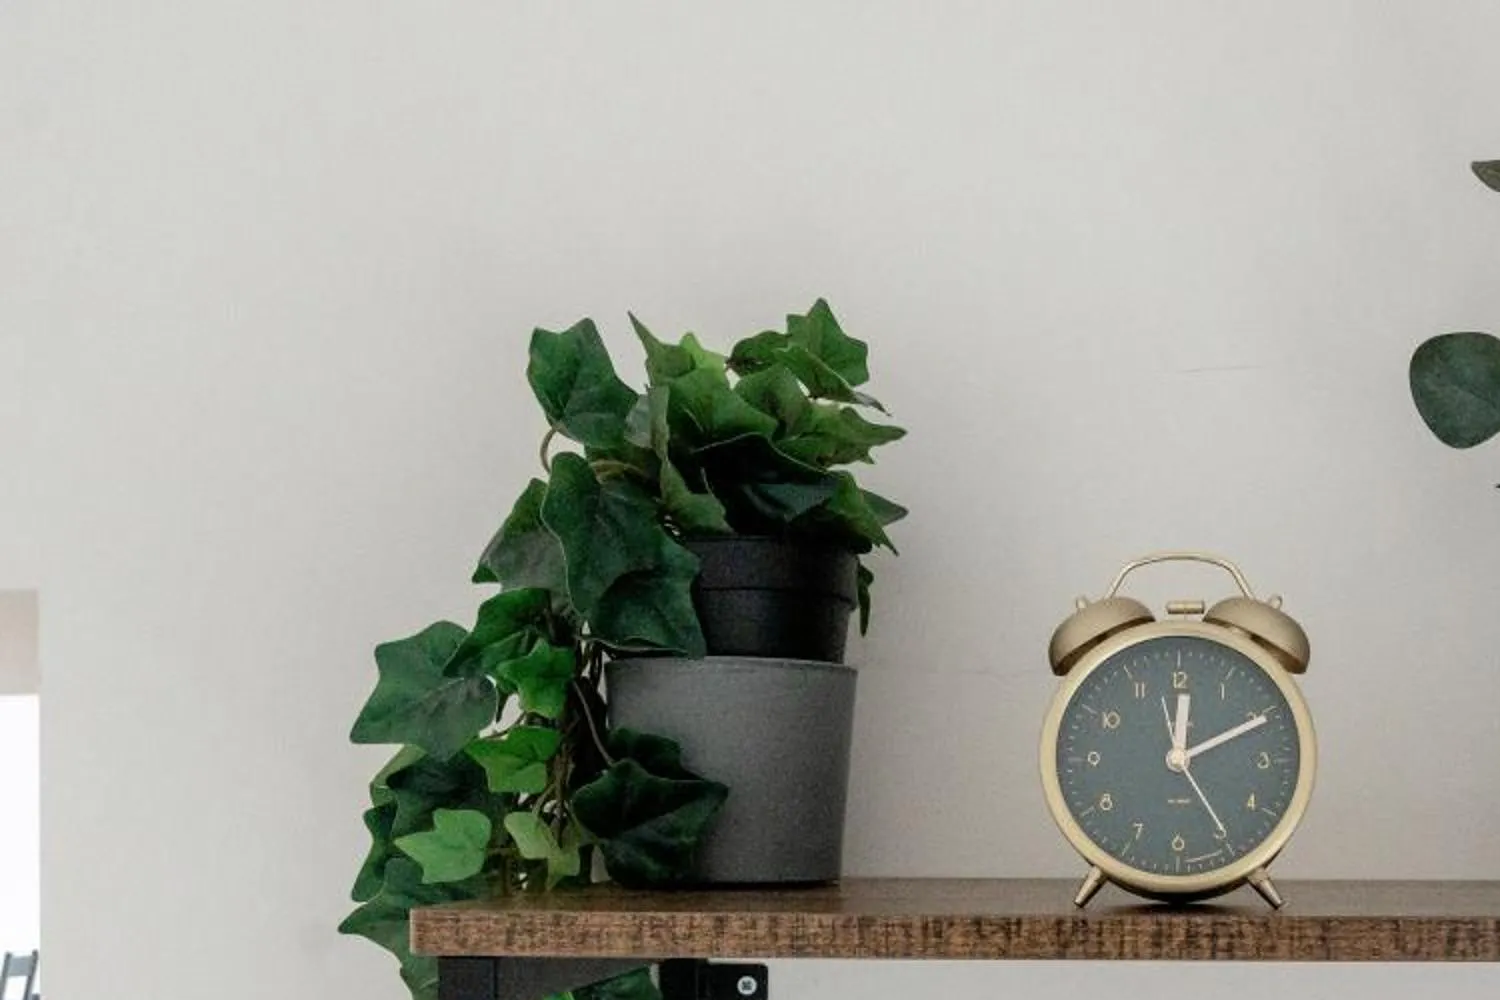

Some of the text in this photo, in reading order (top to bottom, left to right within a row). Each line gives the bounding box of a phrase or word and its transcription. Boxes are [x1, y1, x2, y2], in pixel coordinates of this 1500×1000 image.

[1172, 671, 1188, 688] 12
[1135, 682, 1145, 698] 11
[1220, 682, 1225, 700] 1
[1102, 711, 1120, 728] 10
[1087, 751, 1101, 768] 9
[1257, 752, 1269, 769] 3
[1100, 793, 1113, 811] 8
[1246, 792, 1255, 811] 4
[1132, 822, 1144, 840] 7
[1171, 834, 1185, 851] 6
